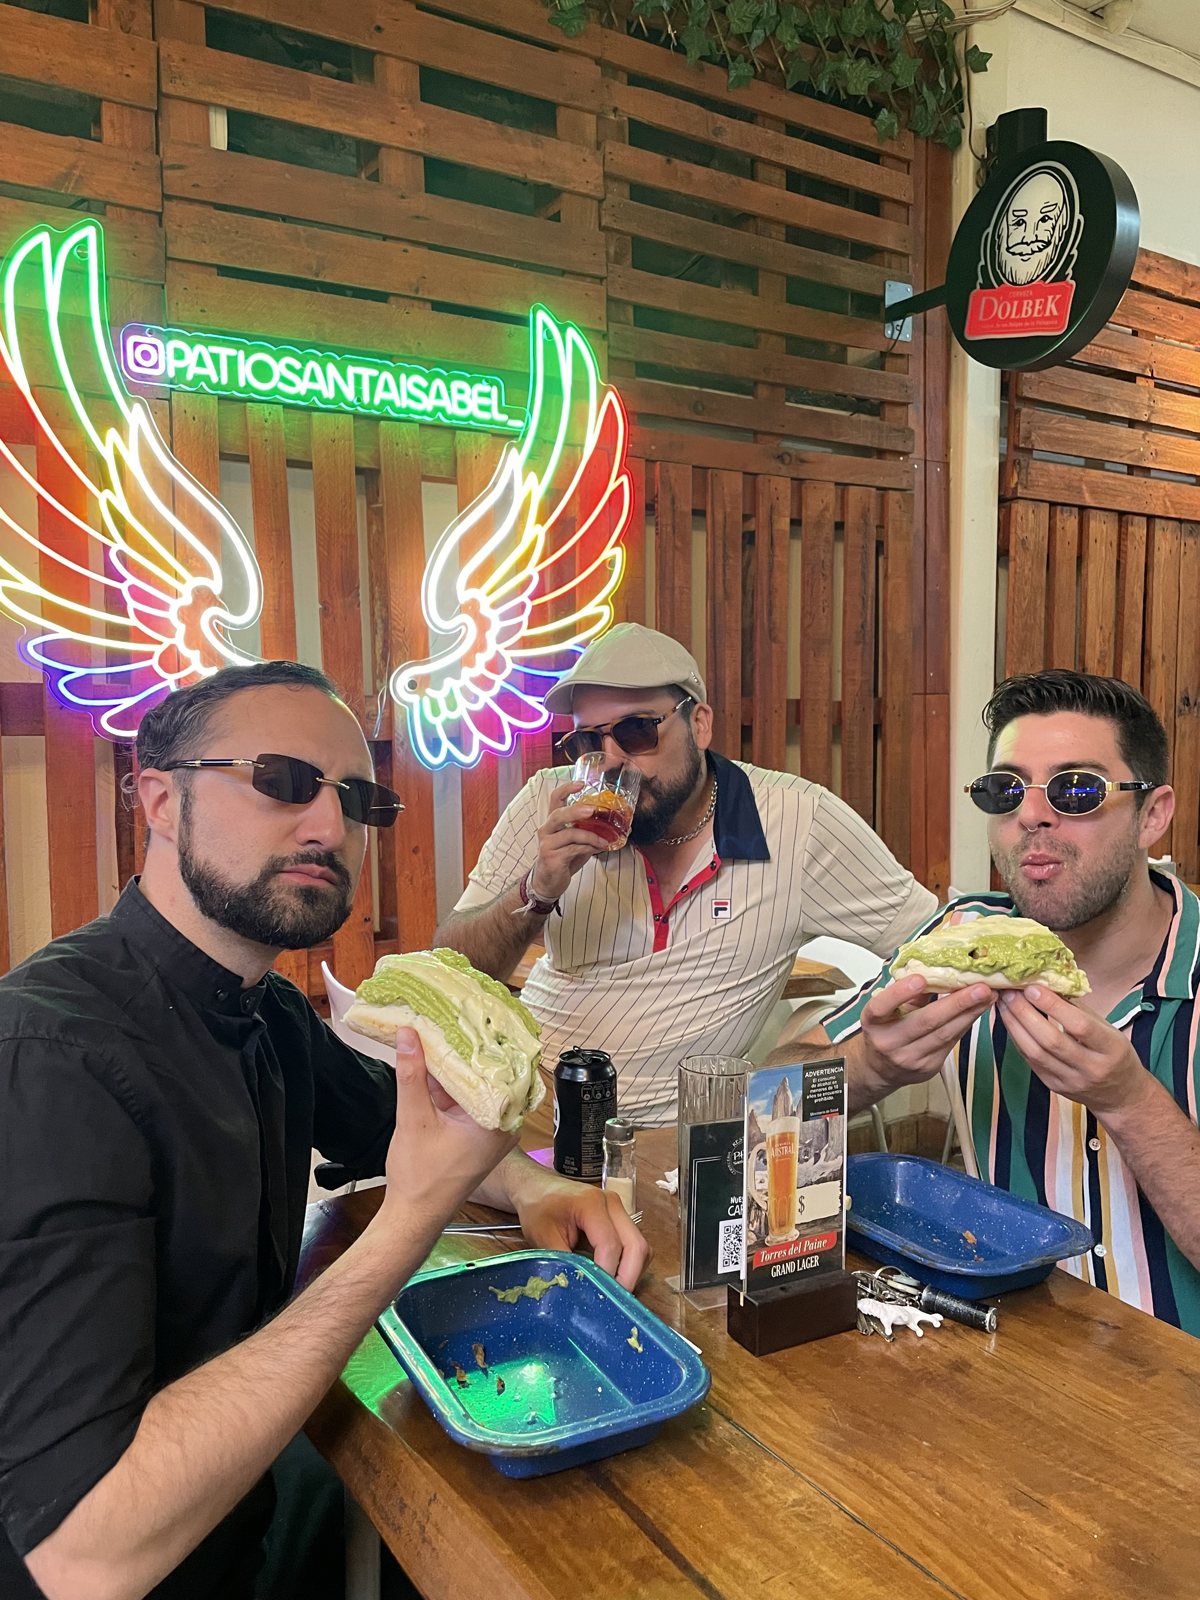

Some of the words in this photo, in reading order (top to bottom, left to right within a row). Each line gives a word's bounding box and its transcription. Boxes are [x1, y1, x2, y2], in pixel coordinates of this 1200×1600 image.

[805, 1066, 844, 1078] ADVERTENCIA
[798, 1195, 805, 1216] $
[760, 1249, 787, 1263] Torres
[788, 1242, 801, 1256] del
[803, 1238, 828, 1252] Paine
[771, 1261, 796, 1278] GRAND
[797, 1255, 820, 1272] LAGER
